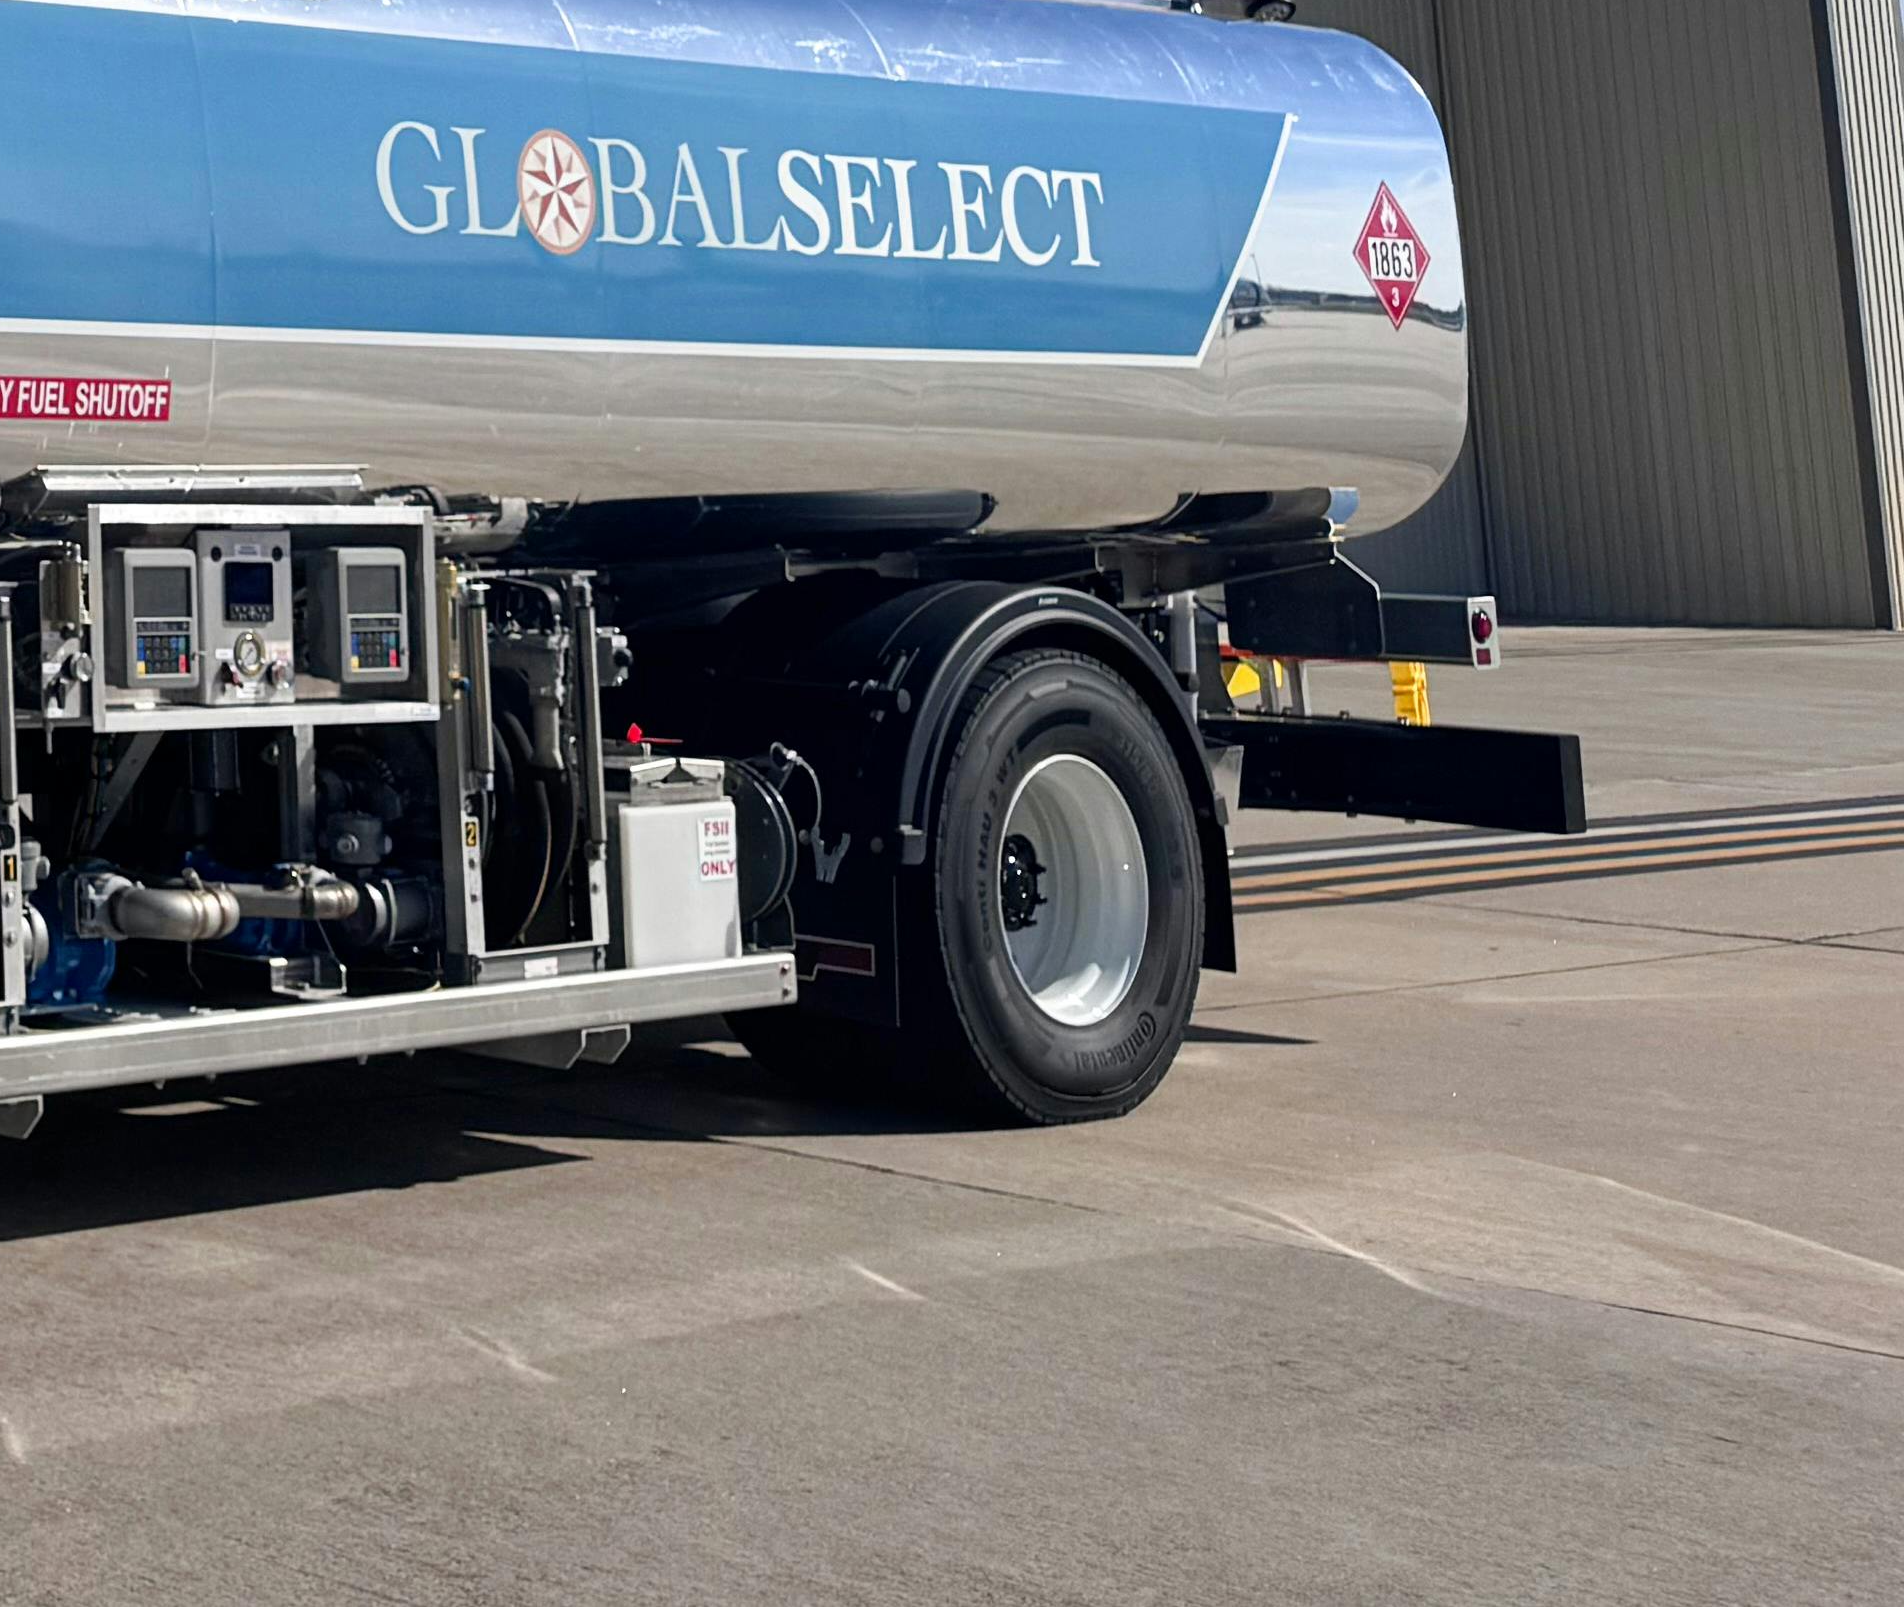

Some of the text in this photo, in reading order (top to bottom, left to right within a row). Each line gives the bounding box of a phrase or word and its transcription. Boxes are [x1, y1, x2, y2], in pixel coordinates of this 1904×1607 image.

[1372, 241, 1413, 279] 1863
[1392, 287, 1400, 307] 3
[17, 380, 70, 414] FUEL
[74, 382, 169, 418] SHUTOFF
[467, 823, 476, 845] 2
[7, 856, 15, 880] 1
[701, 859, 736, 876] ONLY
